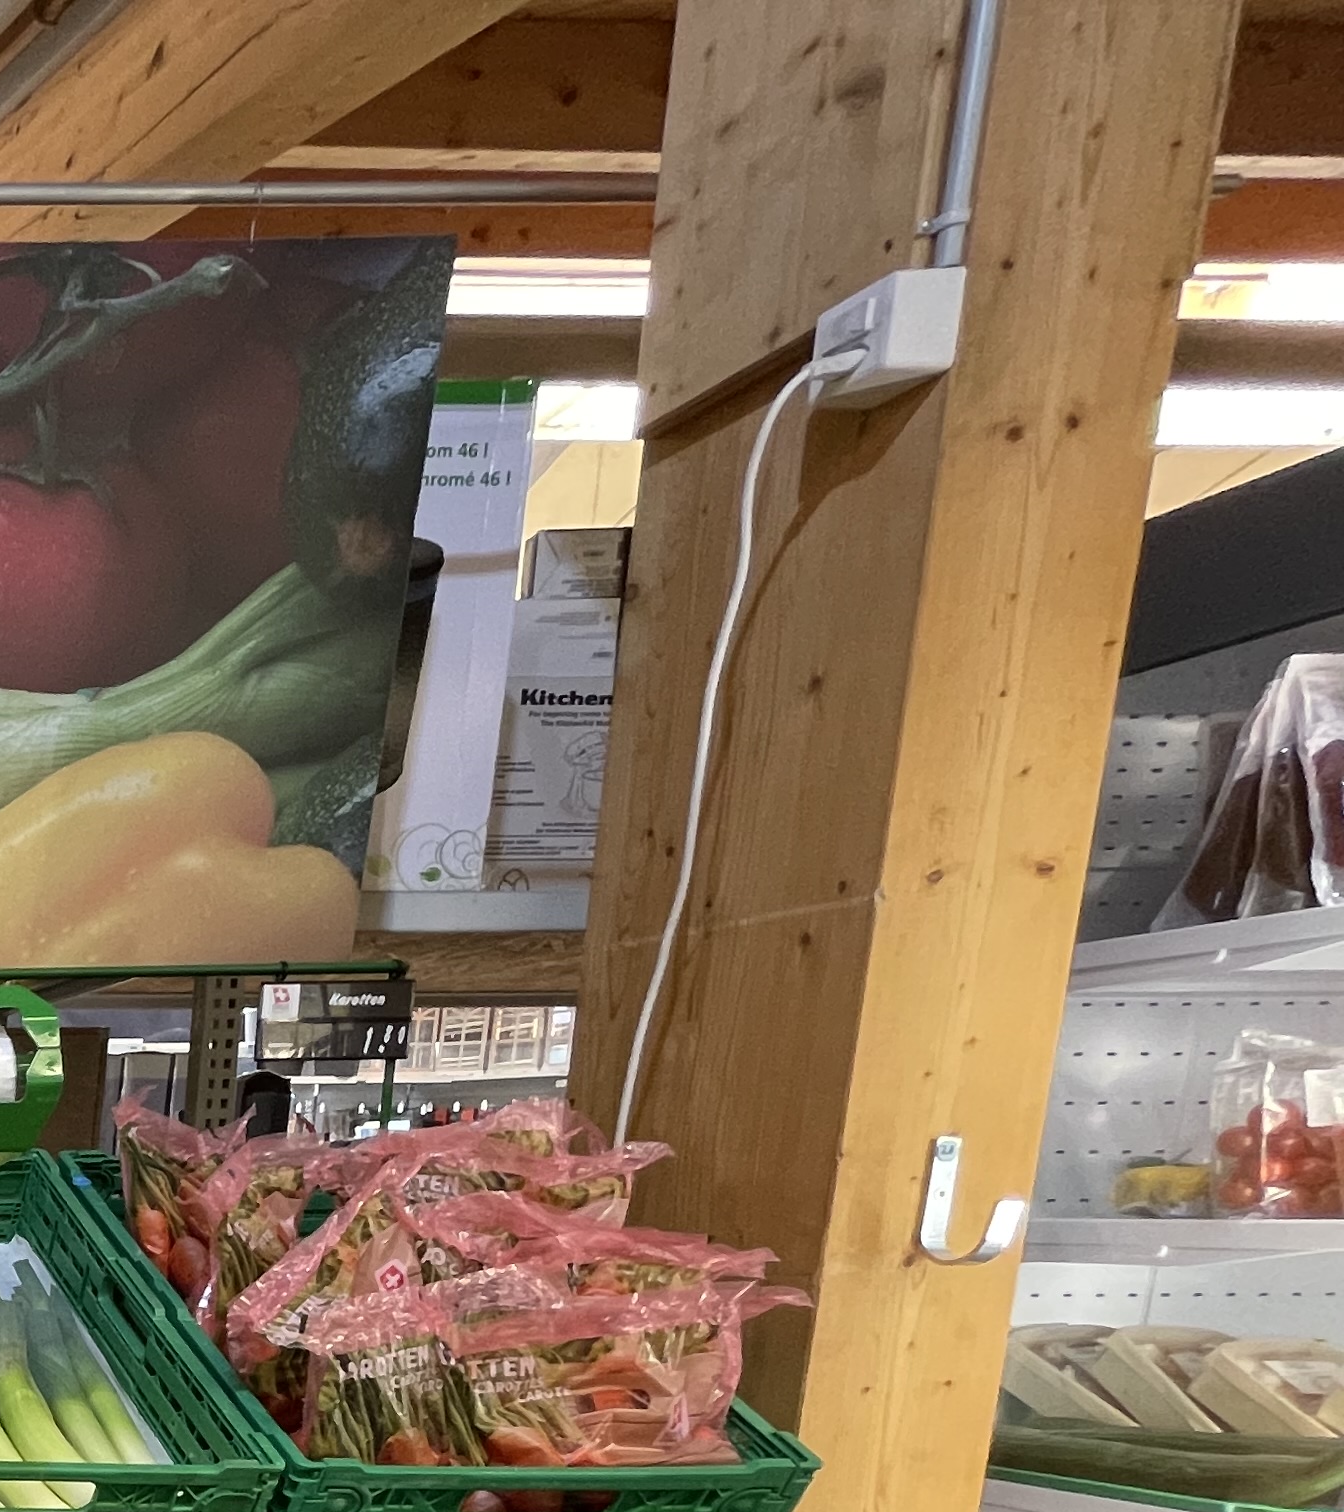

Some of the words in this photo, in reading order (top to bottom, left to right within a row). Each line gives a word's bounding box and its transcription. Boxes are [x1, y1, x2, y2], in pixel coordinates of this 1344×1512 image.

[458, 443, 481, 458] 46
[480, 472, 500, 486] 46
[328, 992, 386, 1007] Karotten
